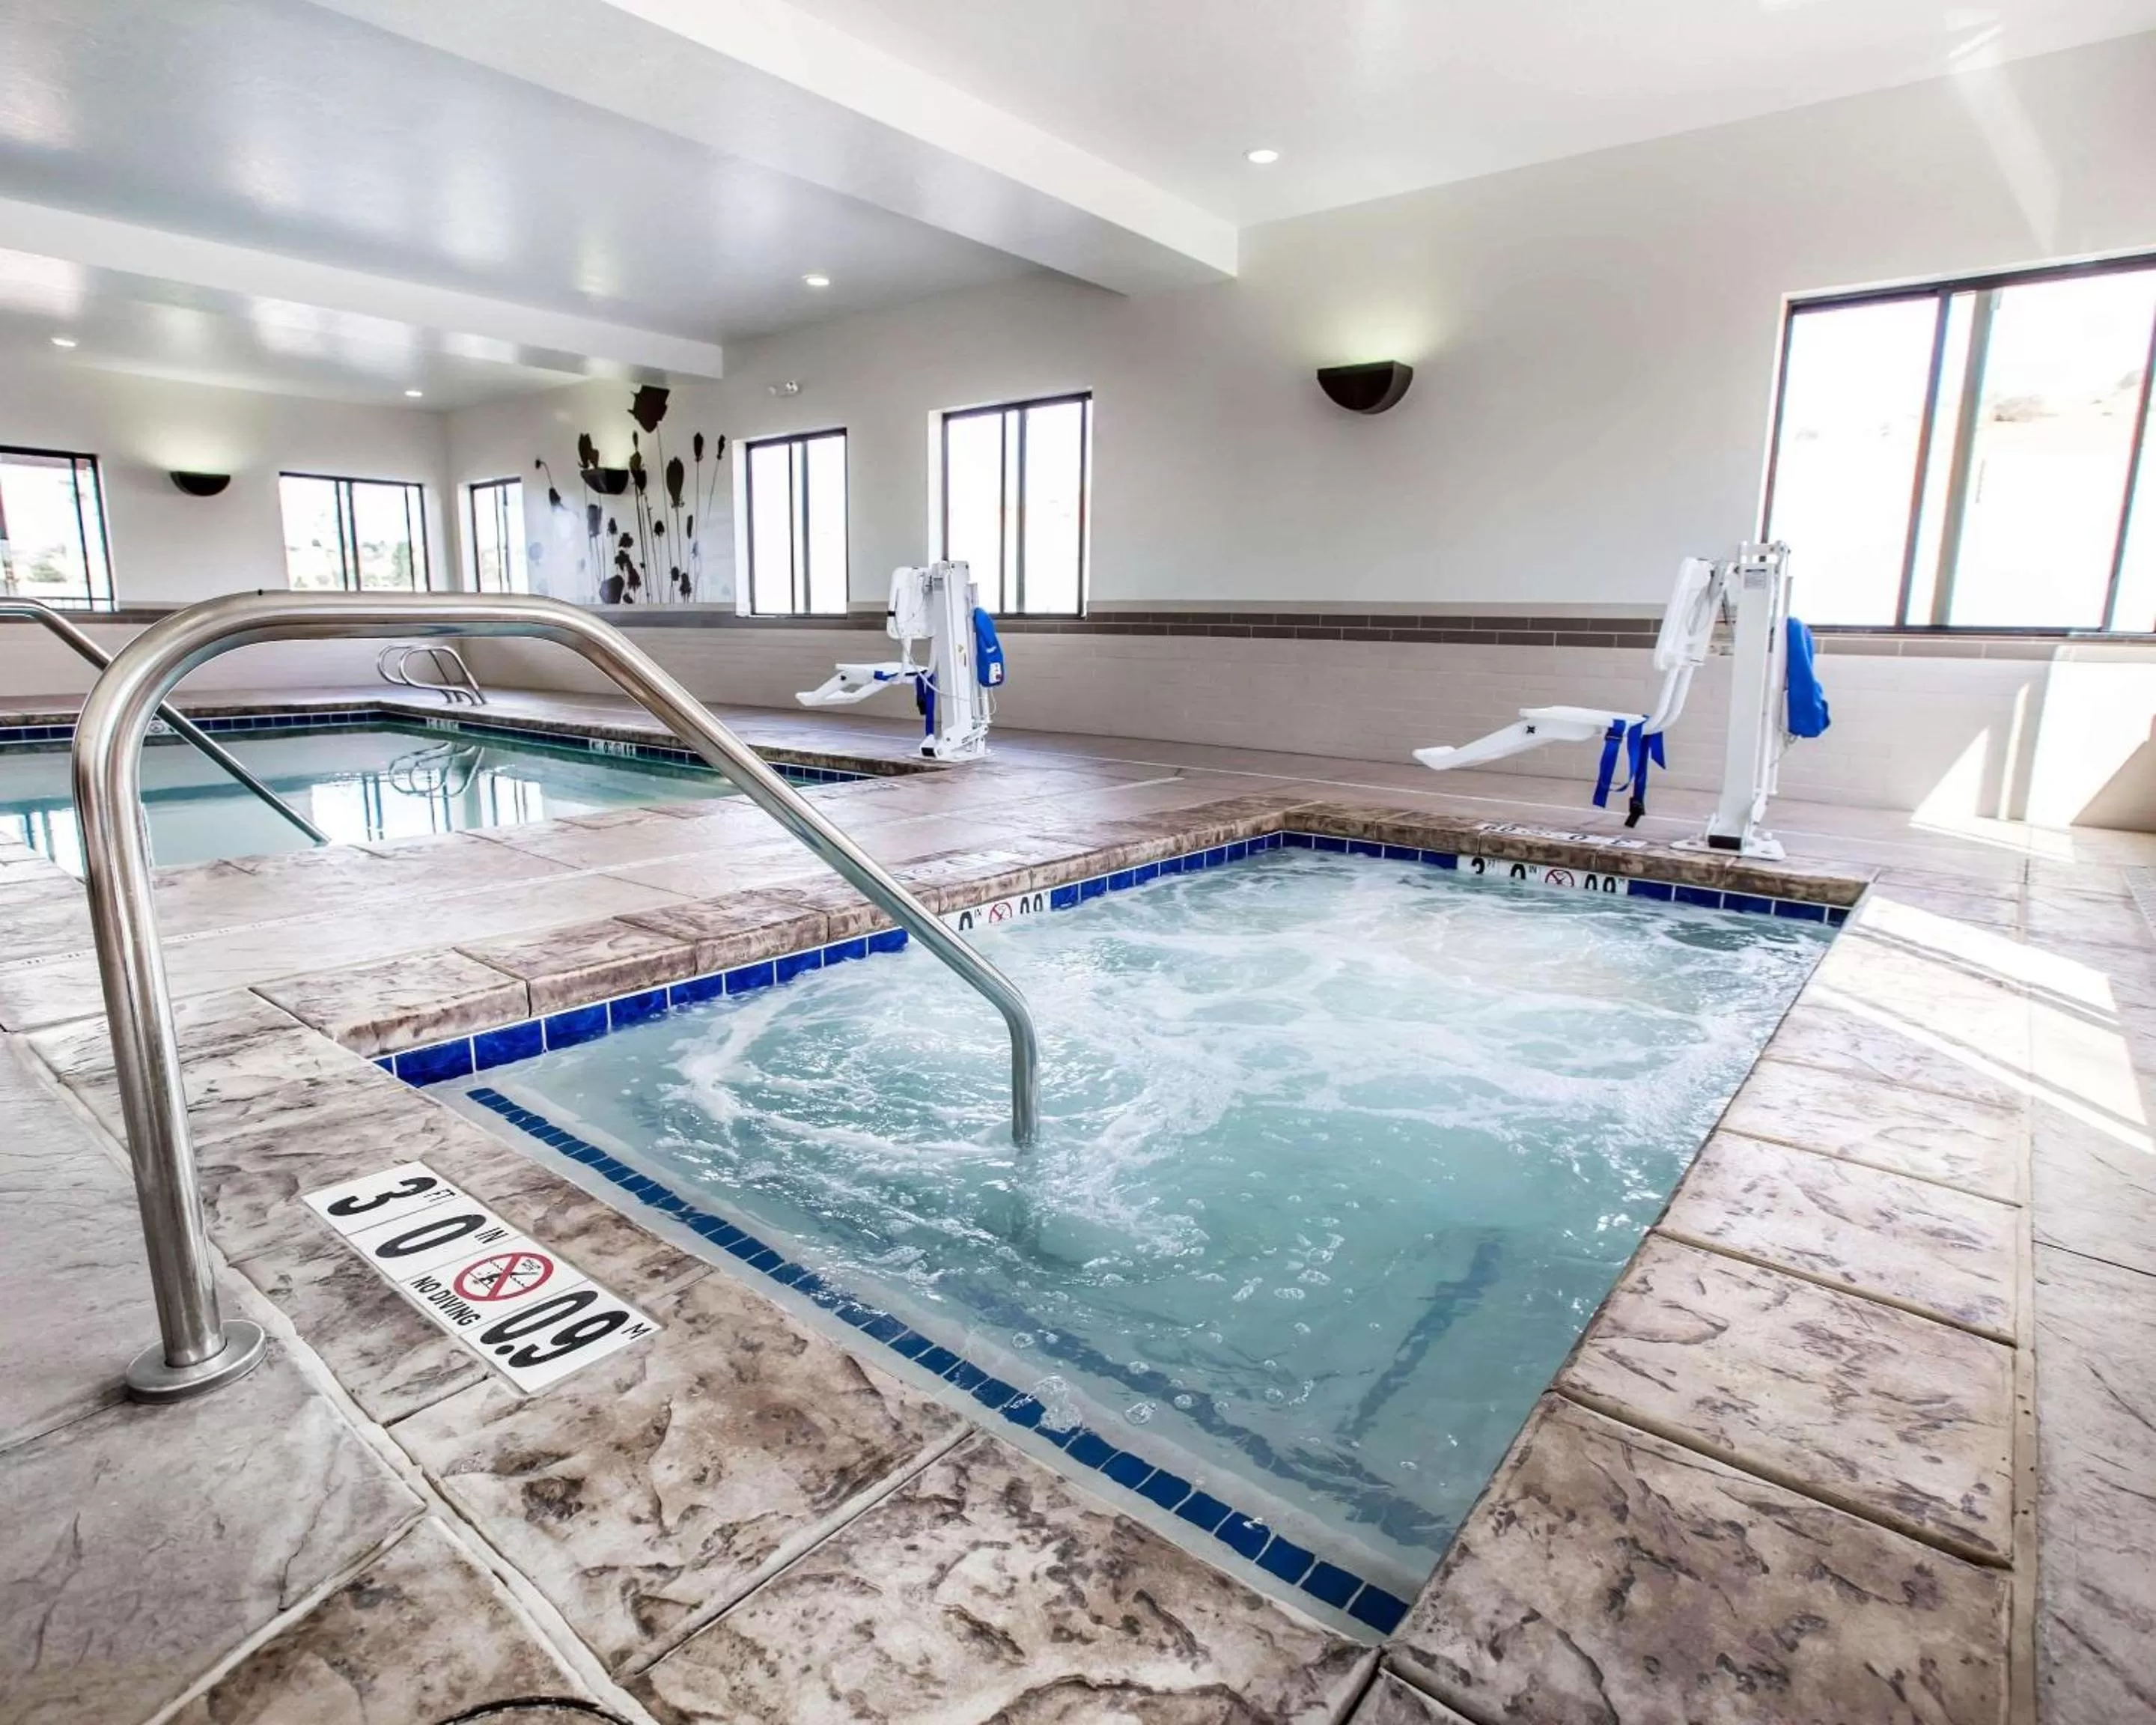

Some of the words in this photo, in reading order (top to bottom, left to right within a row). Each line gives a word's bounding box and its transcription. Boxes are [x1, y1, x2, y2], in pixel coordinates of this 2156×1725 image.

[327, 1177, 438, 1216] 3
[423, 1188, 456, 1202] FT
[375, 1214, 487, 1259] 0
[474, 1227, 509, 1244] IN
[409, 1275, 442, 1294] NO
[427, 1289, 481, 1326] DIVING
[480, 1290, 630, 1368] 0.9
[621, 1322, 652, 1340] M
